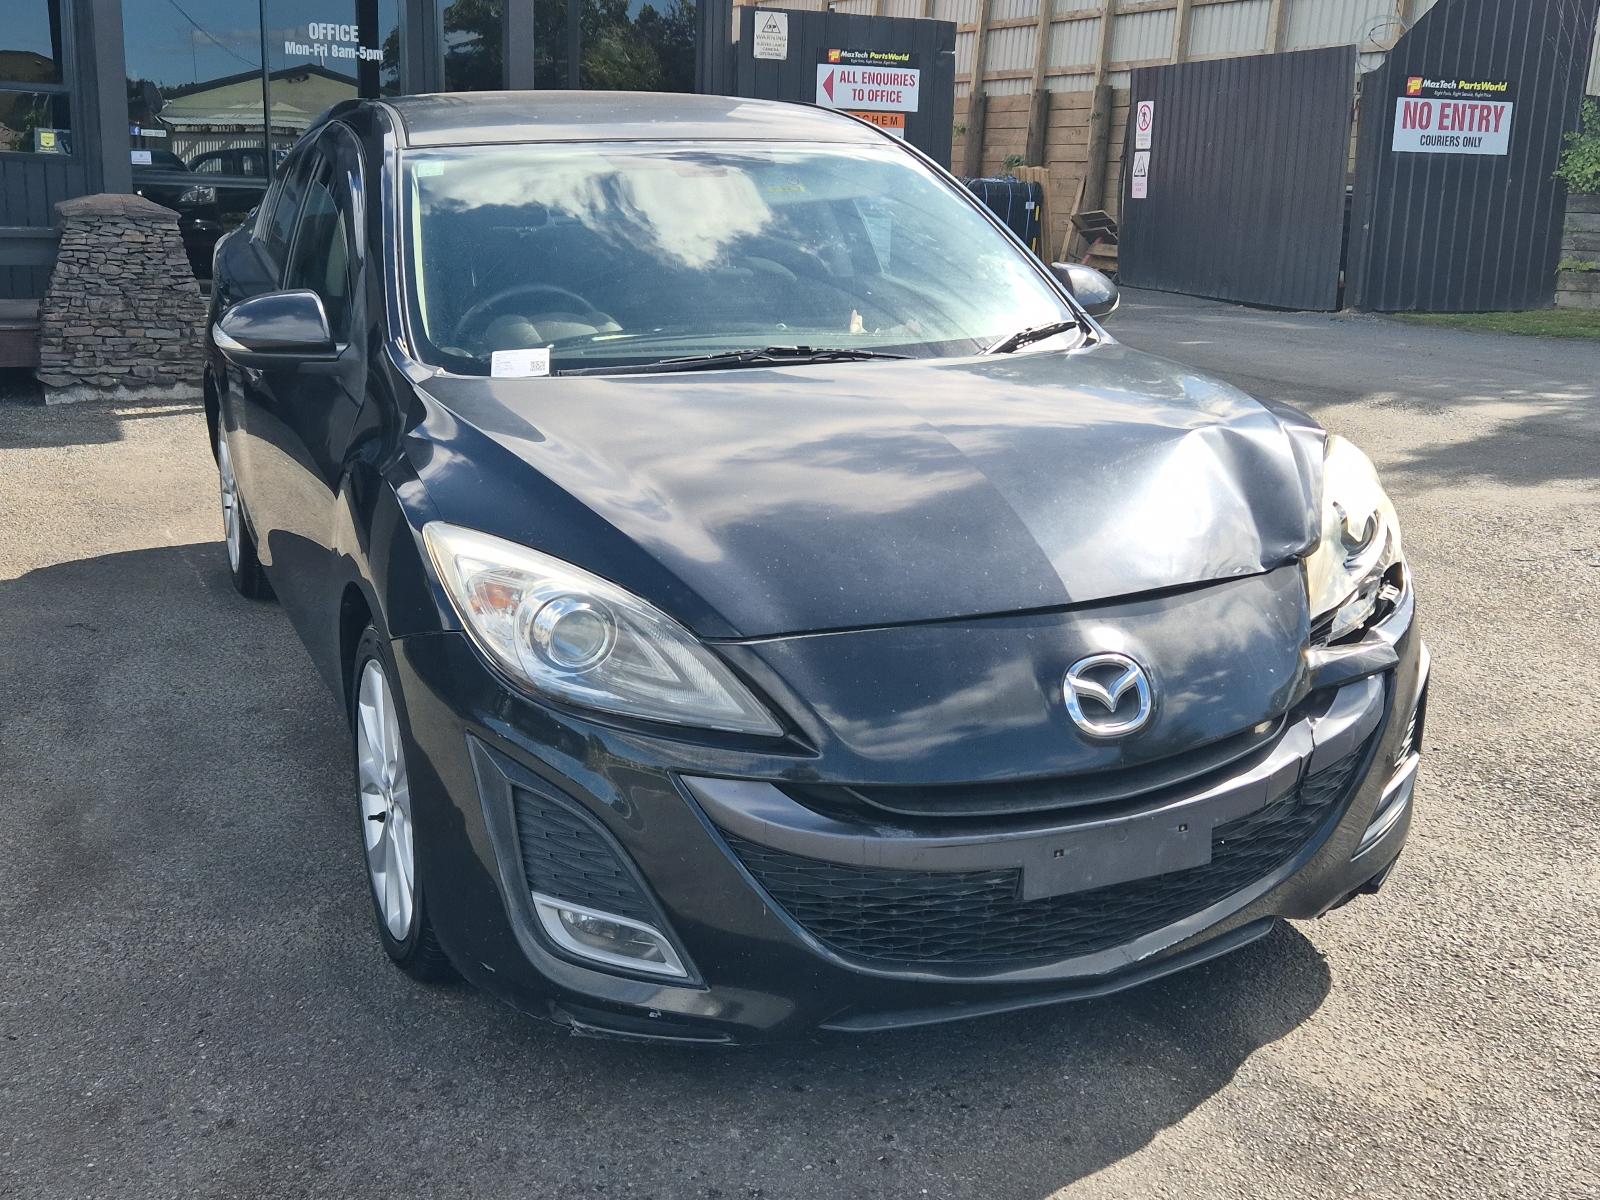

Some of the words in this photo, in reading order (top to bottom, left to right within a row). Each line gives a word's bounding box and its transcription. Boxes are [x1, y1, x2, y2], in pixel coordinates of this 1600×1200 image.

[308, 22, 359, 42] OFFICE
[284, 41, 328, 57] Mon-Fri
[331, 44, 384, 61] 8am-5pm
[840, 50, 868, 58] MazTech
[869, 52, 910, 61] PartsWorld
[840, 71, 858, 84] ALL
[861, 72, 916, 87] ENQUIRIES
[1422, 79, 1456, 89] MazTech
[1458, 80, 1508, 92] PartsWorld
[852, 89, 864, 101] TO
[867, 89, 902, 103] OFFICE
[1402, 101, 1433, 130] NO
[1438, 102, 1505, 133] ENTRY
[1420, 134, 1460, 147] COURIERS
[1462, 136, 1483, 148] ONLY
